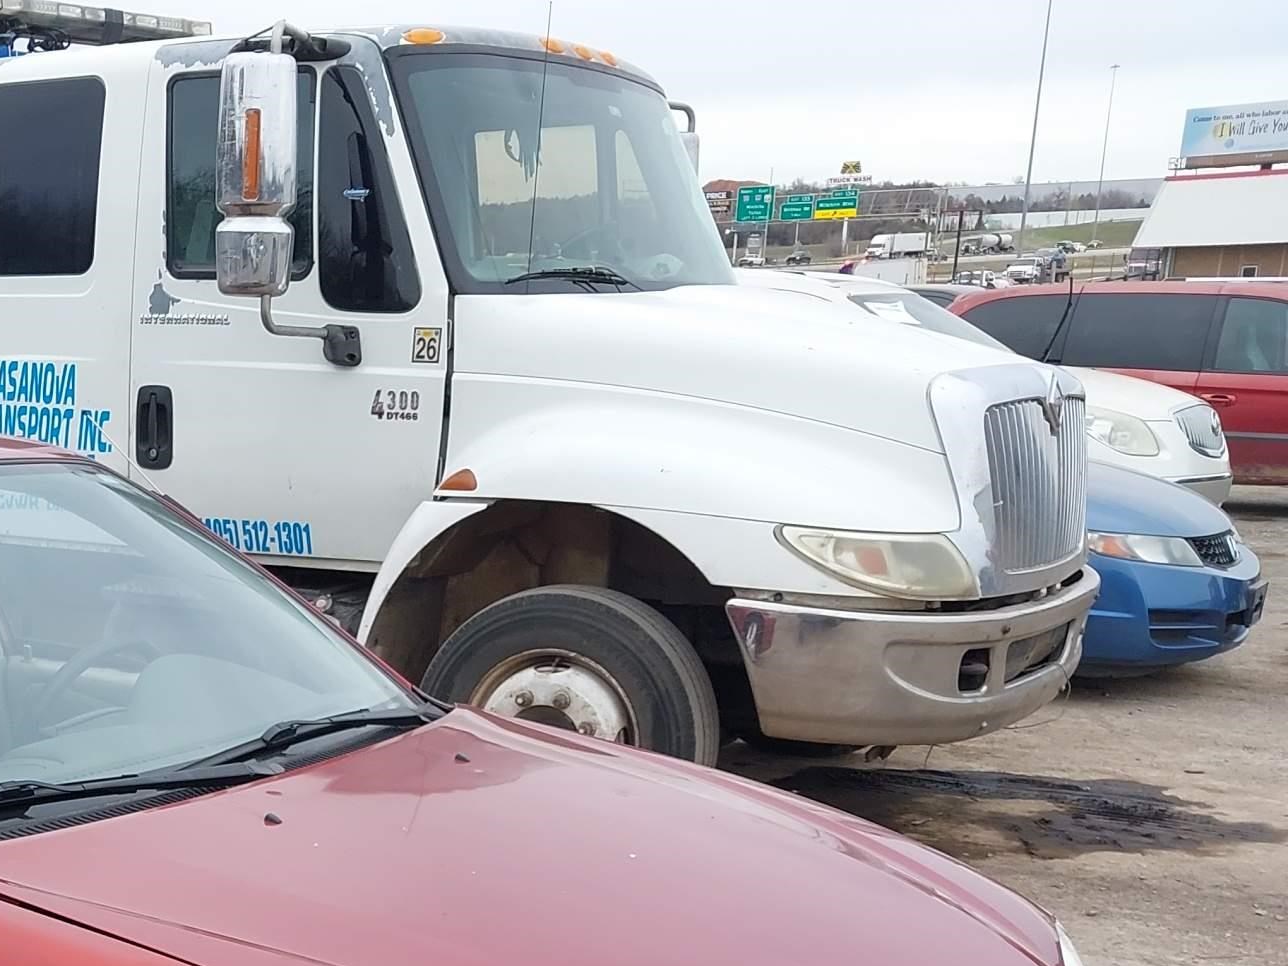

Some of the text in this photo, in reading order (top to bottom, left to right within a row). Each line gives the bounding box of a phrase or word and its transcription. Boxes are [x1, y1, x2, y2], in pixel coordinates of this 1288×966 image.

[1218, 121, 1226, 138] I
[1229, 121, 1245, 137] Will
[1248, 119, 1269, 136] Give
[140, 314, 230, 325] INTERNATIONAL
[415, 337, 437, 360] 26
[371, 389, 420, 420] 4300
[386, 411, 418, 420] DT466
[78, 409, 112, 452] INC.
[241, 519, 312, 555] 512-1301
